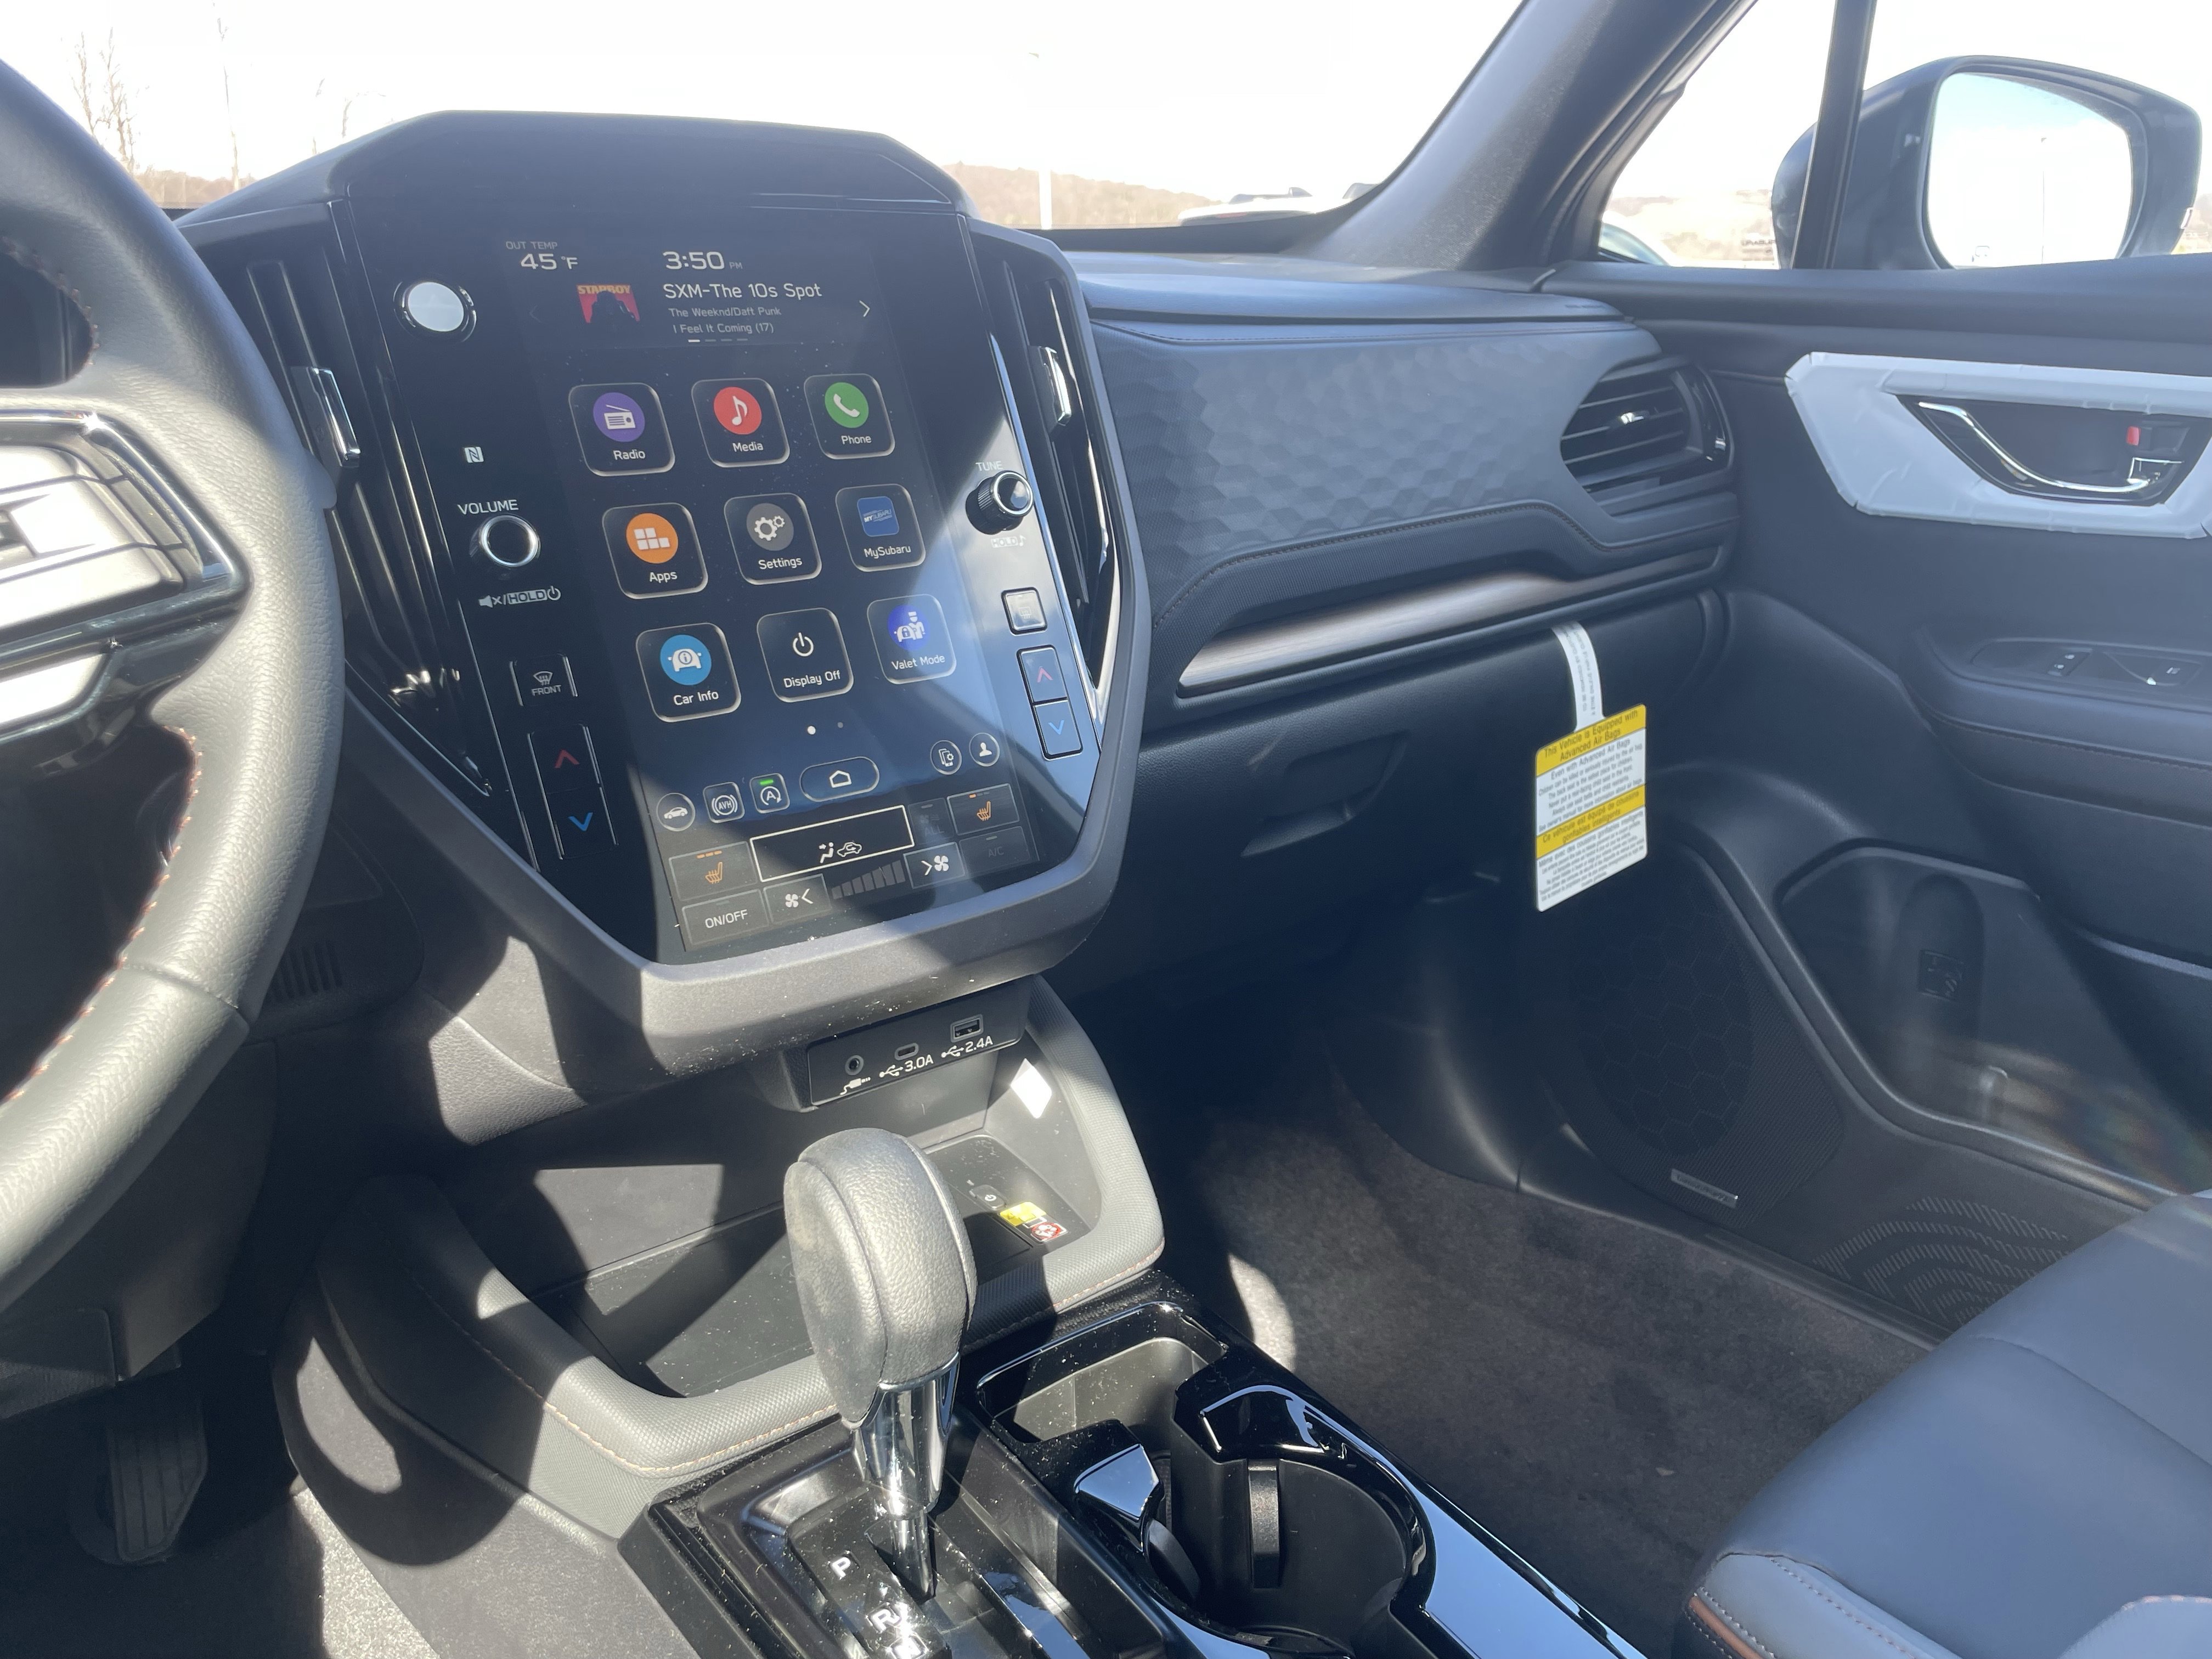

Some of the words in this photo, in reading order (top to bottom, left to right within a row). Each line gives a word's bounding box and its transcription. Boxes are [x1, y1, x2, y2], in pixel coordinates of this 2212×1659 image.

[506, 241, 526, 250] OUT
[531, 241, 557, 250] TEMP
[521, 253, 557, 269] 45
[663, 251, 725, 270] 3:50
[663, 283, 742, 299] SXM-The
[748, 283, 778, 298] 10s
[783, 283, 822, 300] Spot
[668, 308, 689, 318] The
[692, 307, 755, 317] Weeknd/Daft
[758, 306, 781, 316] Punk
[673, 324, 677, 334] I
[680, 324, 703, 334] Feel
[706, 324, 714, 333] It
[718, 323, 752, 334] Coming
[755, 323, 774, 334] (17)
[841, 434, 872, 445] Phone
[732, 442, 764, 453] Media
[613, 449, 646, 461] Radio
[975, 461, 1003, 471] TUNE
[457, 499, 518, 515] VOLUME
[991, 537, 1018, 548] HOLD
[864, 546, 911, 558] MySubaru
[758, 557, 803, 571] Settings
[649, 571, 678, 583] Apps
[891, 657, 917, 670] Valet
[920, 653, 945, 667] Mode
[783, 673, 822, 689] Display
[825, 670, 841, 681] Off
[531, 685, 562, 696] FRONT
[673, 693, 693, 706] Car
[698, 690, 719, 702] Info
[1544, 748, 1556, 758] This
[1559, 734, 1582, 750] Vehicle
[1593, 716, 1622, 736] Equipped
[1625, 710, 1638, 721] with
[1560, 741, 1590, 762] Advanced
[1593, 736, 1601, 746] Air
[1605, 729, 1620, 743] Bags
[718, 800, 732, 811] AVH
[988, 846, 1005, 857] A/C
[705, 909, 748, 928] ON/OFF
[905, 1054, 934, 1072] 3.0A
[965, 1036, 993, 1053] 2.4A
[831, 1557, 851, 1579] P
[870, 1609, 900, 1633] R
